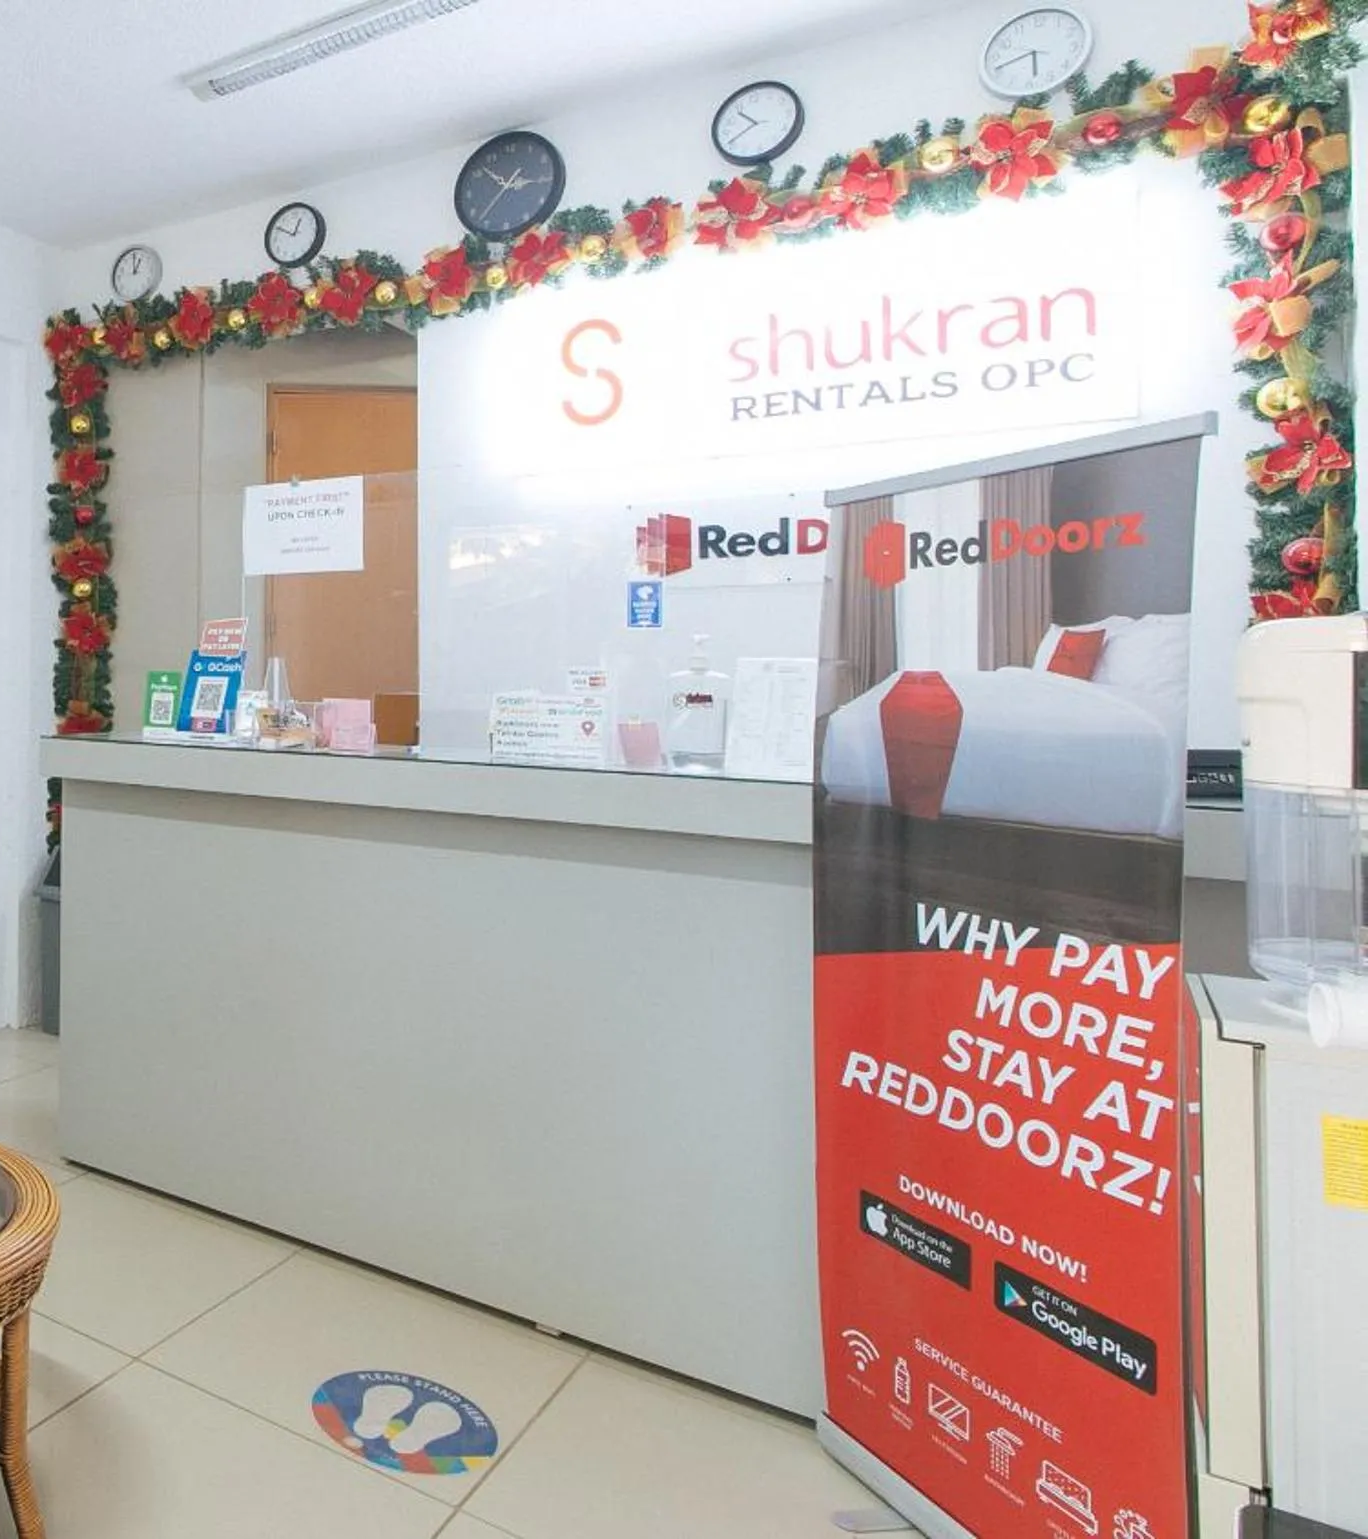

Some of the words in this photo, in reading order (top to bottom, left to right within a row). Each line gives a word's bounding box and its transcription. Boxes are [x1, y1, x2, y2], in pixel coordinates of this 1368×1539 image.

[728, 285, 1098, 383] shukran
[731, 371, 960, 421] RENTALS
[981, 353, 1097, 391] OPC
[698, 517, 829, 560] RedD
[909, 511, 1147, 570] RedDoorz
[915, 902, 1041, 967] WHY
[1048, 932, 1176, 1000] PAY
[974, 977, 1166, 1082] MORE,
[941, 1028, 1077, 1106] STAY
[1082, 1080, 1175, 1141] AT
[840, 1050, 1173, 1216] REDDOORZ!
[891, 1213, 926, 1243] Download
[892, 1226, 917, 1252] App
[916, 1239, 952, 1270] Store
[898, 1174, 1016, 1247] DOWNLOAD
[1020, 1235, 1089, 1284] NOW!
[1031, 1284, 1052, 1302] GET
[1050, 1294, 1061, 1308] IT
[1060, 1299, 1078, 1317] ON
[1031, 1300, 1099, 1352] Google
[1101, 1338, 1148, 1381] Play
[357, 1372, 410, 1384] PLEASE
[414, 1379, 462, 1406] STAND
[913, 1337, 971, 1383] SERVICE
[970, 1375, 1064, 1445] GUARANTEE
